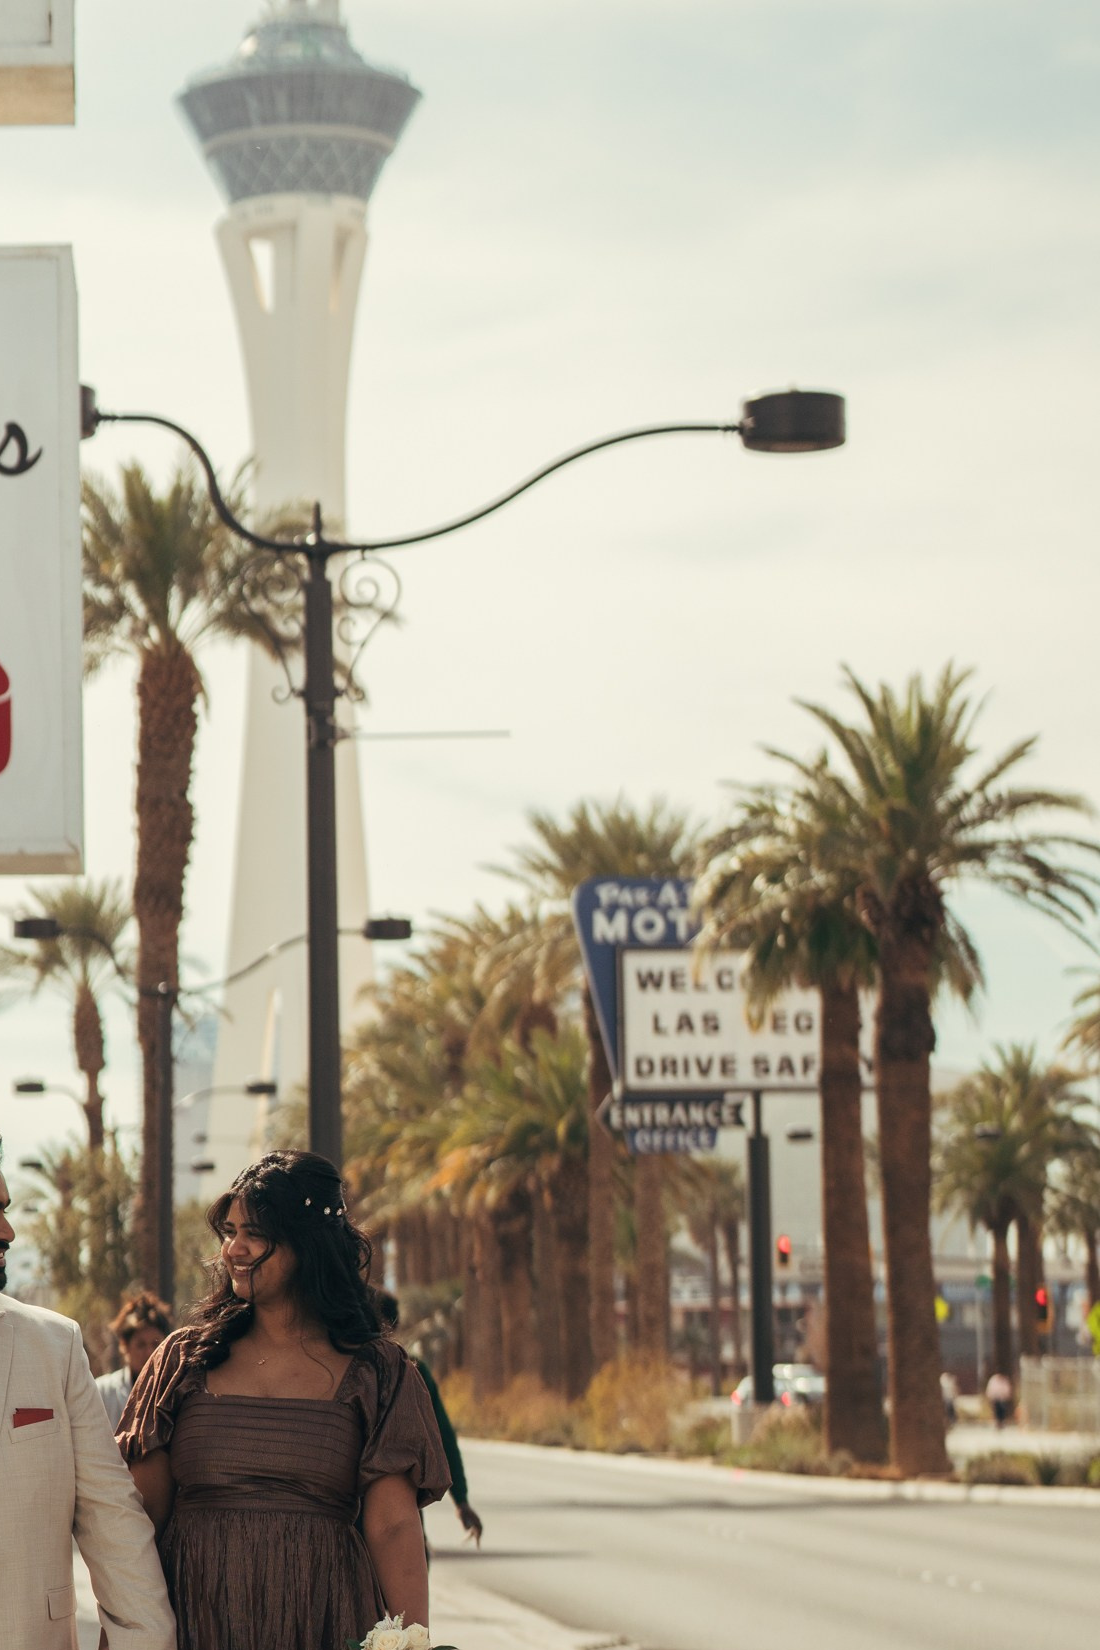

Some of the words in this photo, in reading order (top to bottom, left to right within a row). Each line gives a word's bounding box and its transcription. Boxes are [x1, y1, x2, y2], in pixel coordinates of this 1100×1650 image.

[590, 907, 691, 946] MOT
[636, 966, 748, 993] WELC
[651, 1009, 722, 1037] LAS
[634, 1053, 739, 1079] DRIVE
[609, 1101, 737, 1130] ENTRANCE
